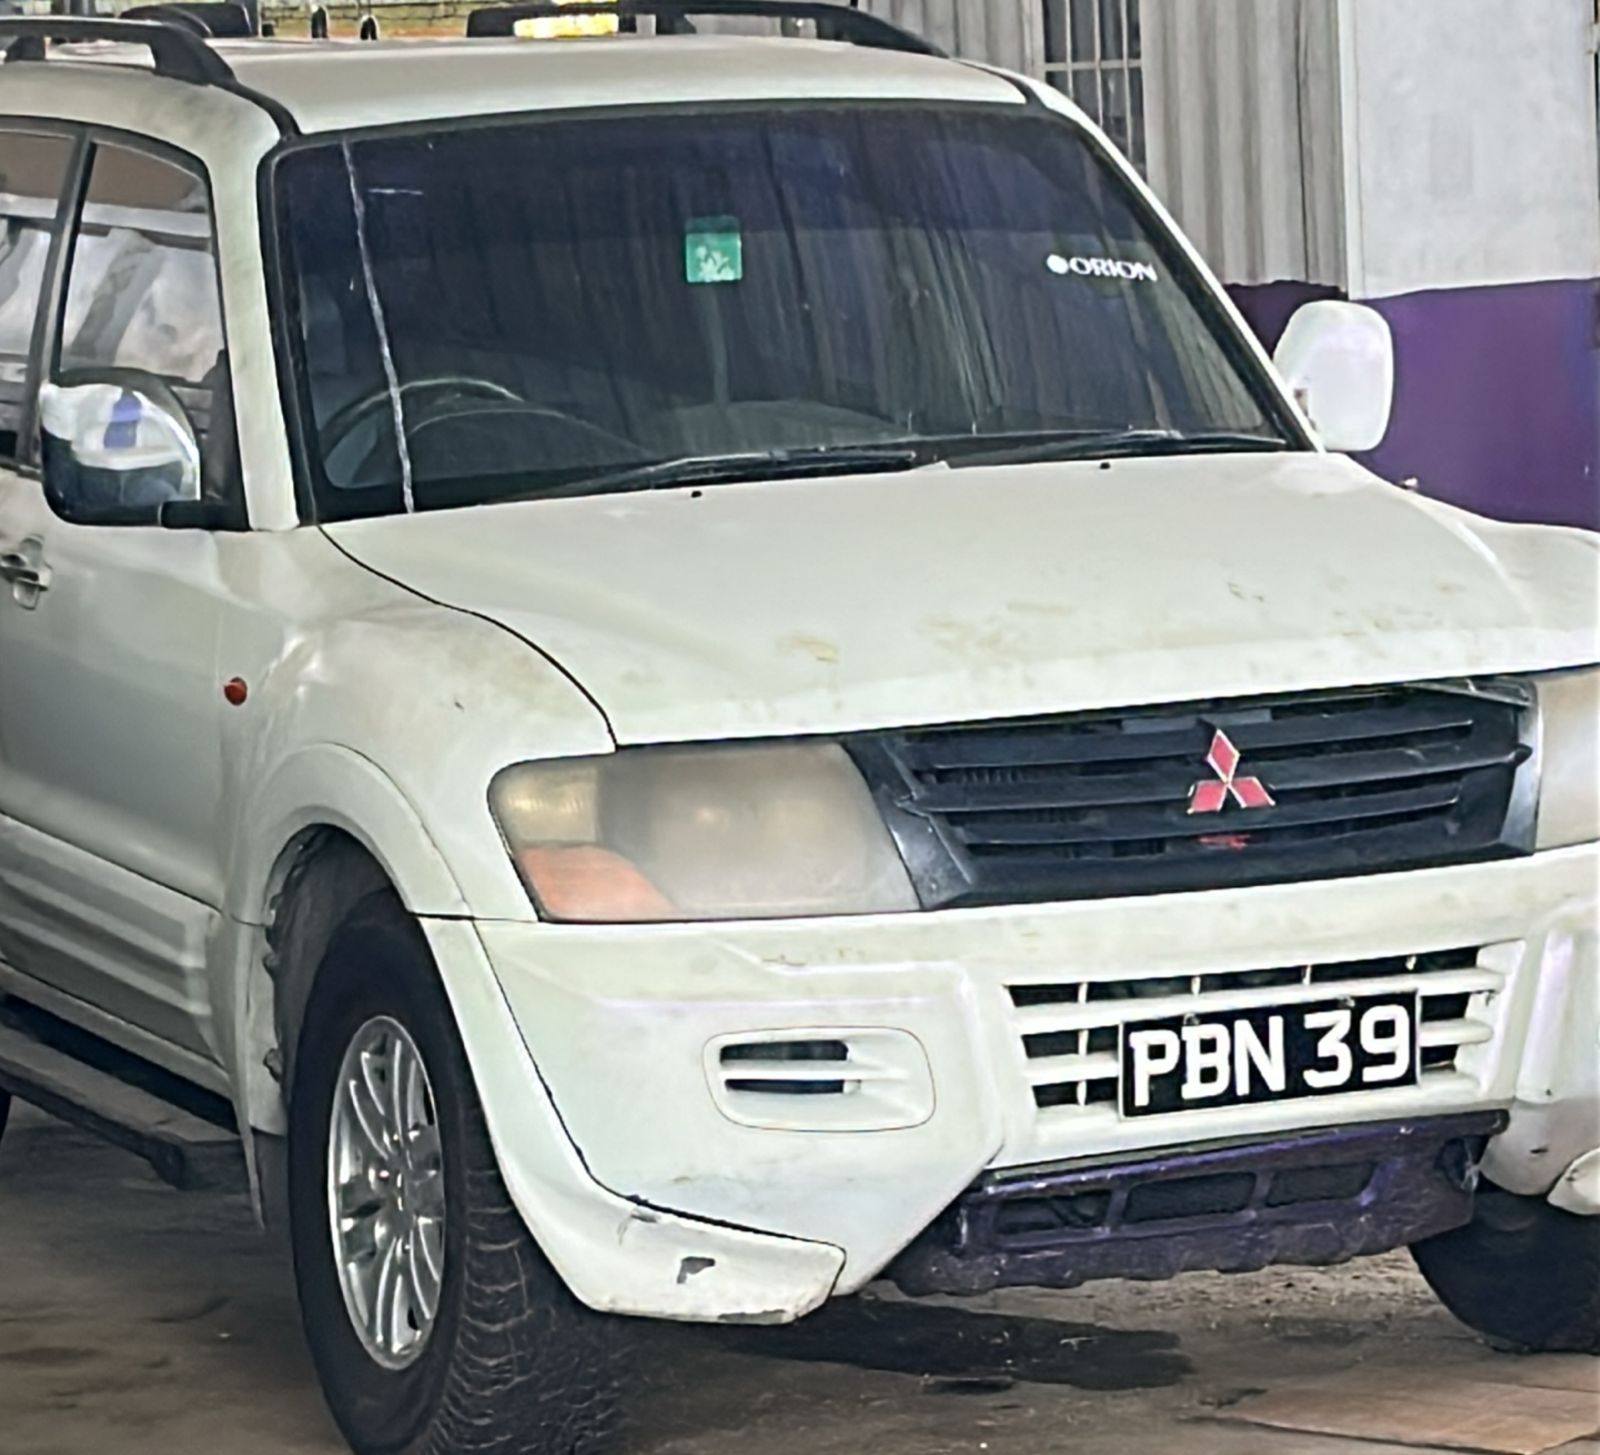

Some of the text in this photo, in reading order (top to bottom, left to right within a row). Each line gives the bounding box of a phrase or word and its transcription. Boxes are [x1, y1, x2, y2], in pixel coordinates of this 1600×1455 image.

[1069, 257, 1158, 283] ORION
[1129, 1004, 1410, 1107] PBN 39
